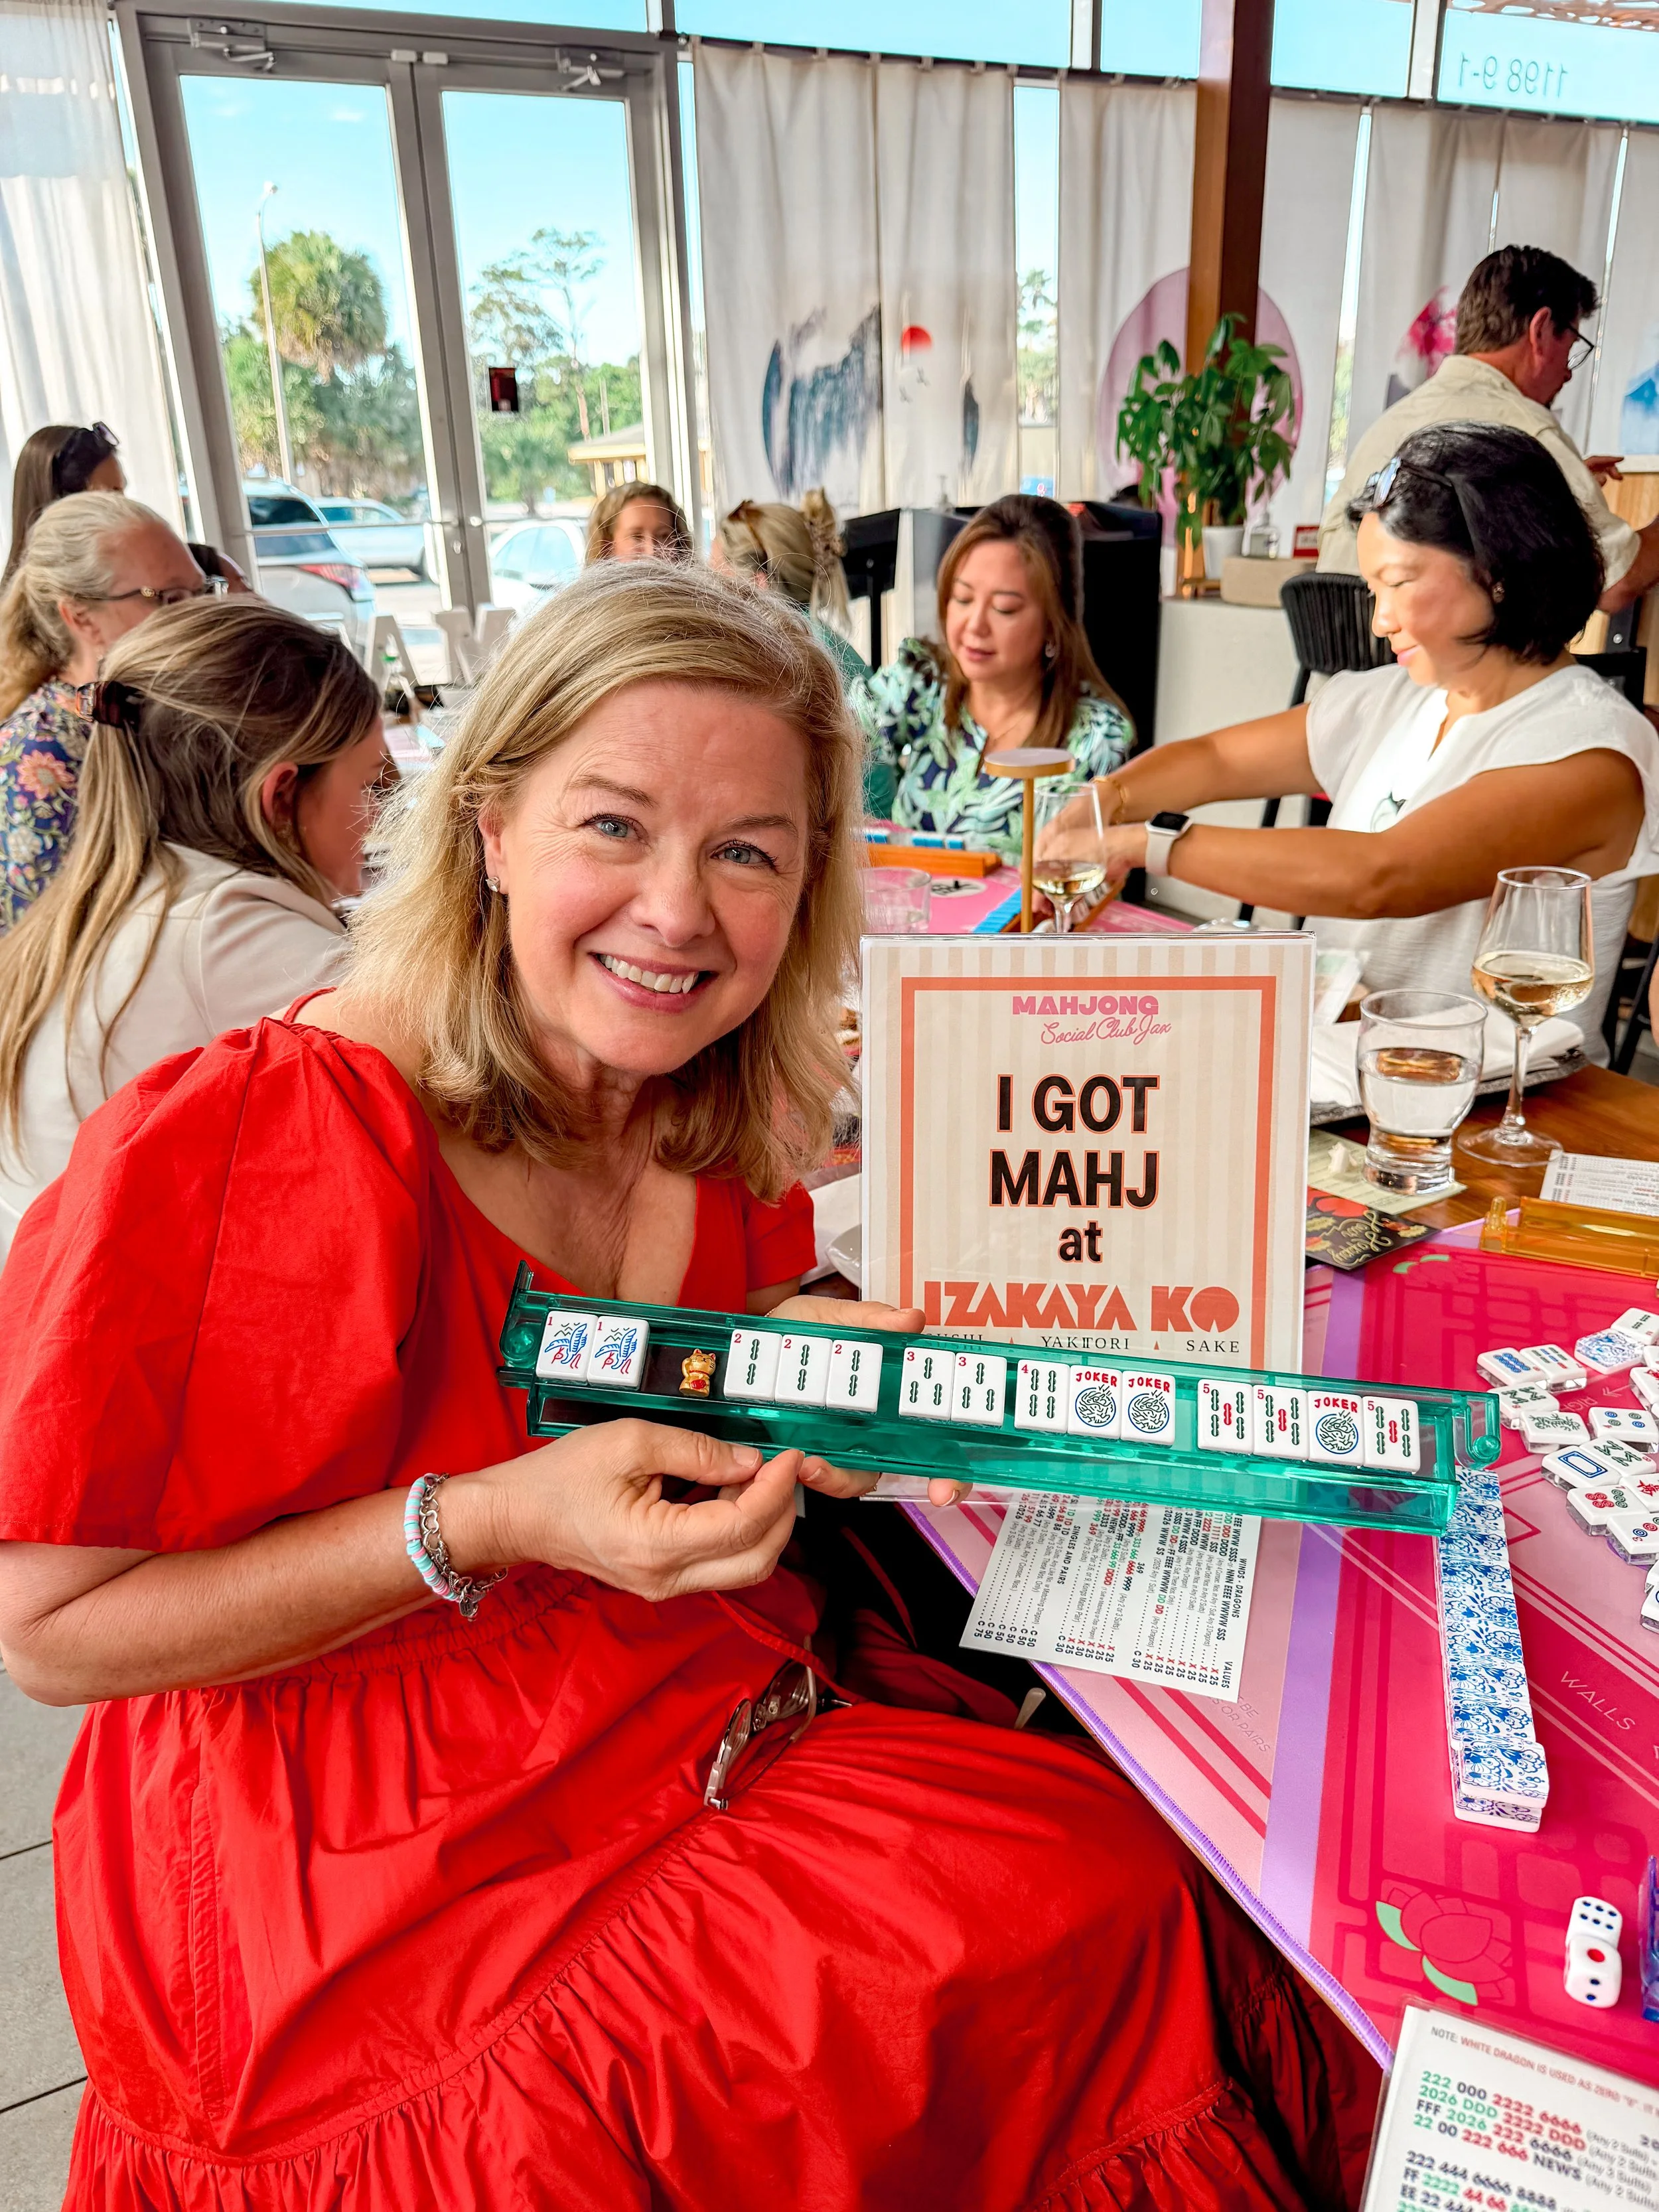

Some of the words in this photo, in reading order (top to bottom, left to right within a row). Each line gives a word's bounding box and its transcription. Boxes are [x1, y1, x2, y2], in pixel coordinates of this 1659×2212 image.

[1013, 995, 1159, 1015] MAHJONG
[1041, 1021, 1096, 1044] Social
[1096, 1017, 1137, 1039] Club
[997, 1074, 1013, 1133] I
[1031, 1073, 1160, 1134] GOT
[989, 1149, 1160, 1209] MAHJ
[1057, 1220, 1103, 1263] at
[924, 1281, 1138, 1331] IZAKAYA
[1151, 1286, 1240, 1333] KO
[547, 1316, 553, 1326] 1
[597, 1321, 603, 1331] 1
[734, 1333, 742, 1344] 2
[784, 1338, 792, 1349] 2
[1041, 1336, 1129, 1350] YAKITORI
[1187, 1339, 1240, 1353] SAKE
[835, 1344, 843, 1355] 2
[907, 1351, 915, 1361] 3
[959, 1357, 967, 1366] 3
[1021, 1364, 1029, 1373] 4
[1076, 1371, 1118, 1387] JOKER
[1128, 1377, 1170, 1393] JOKER
[1203, 1384, 1210, 1394] 5
[1258, 1390, 1264, 1400] 5
[1314, 1397, 1358, 1414] JOKER
[1368, 1401, 1374, 1411] 5
[1099, 1513, 1110, 1527] 3333
[1107, 1517, 1118, 1534] NEWS
[1181, 1517, 1192, 1534] WWW
[1192, 1518, 1201, 1527] FFF
[1202, 1518, 1212, 1532] 2222
[1233, 1517, 1242, 1526] EEE
[1088, 1522, 1098, 1534] 369
[1171, 1525, 1179, 1534] DD
[1066, 1525, 1081, 1549] SINGLES
[1132, 1538, 1141, 1548] 333
[1157, 1527, 1169, 1545] WWW
[1189, 1528, 1200, 1545] DDDD
[1198, 1533, 1209, 1550] WWW
[1230, 1528, 1240, 1546] WWW
[1177, 1539, 1187, 1553] SSSS
[1208, 1541, 1218, 1552] SSS
[1218, 1538, 1228, 1556] DDDD
[1062, 1550, 1073, 1564] AND
[1129, 1548, 1139, 1559] 666
[1228, 1547, 1238, 1562] SSSS
[1125, 1560, 1135, 1575] 6666
[1135, 1562, 1145, 1574] 369
[1164, 1556, 1173, 1568] EEEE
[1236, 1558, 1247, 1578] WINDS
[1056, 1566, 1068, 1584] PAIRS
[1159, 1569, 1171, 1593] WWWW
[1224, 1568, 1234, 1584] NNN
[1121, 1576, 1132, 1591] 9999
[1156, 1593, 1166, 1603] DD
[1222, 1584, 1232, 1598] EEEE
[1231, 1584, 1243, 1618] DRAGONS
[1155, 1604, 1164, 1614] DD
[1218, 1600, 1230, 1627] WWWW
[1216, 1627, 1226, 1641] SSS
[1131, 1658, 1140, 1668] 30
[1143, 1660, 1152, 1670] 25
[1153, 1662, 1163, 1672] 25
[1165, 1665, 1174, 1675] 25
[1175, 1667, 1185, 1678] 25
[1187, 1670, 1196, 1680] 25
[1198, 1672, 1207, 1683] 25
[1220, 1660, 1232, 1688] VALUES
[1208, 1675, 1218, 1686] 25
[1560, 1670, 1636, 1730] WALLS
[1221, 1706, 1240, 1722] OR
[1238, 1723, 1271, 1753] PAIRS
[1431, 2026, 1459, 2043] NOTE:
[1461, 2035, 1492, 2055] WHITE
[1421, 2071, 1452, 2089] 222
[1492, 2093, 1534, 2118] 2222
[1539, 2110, 1582, 2136] 6666
[1418, 2085, 1457, 2106] 2026
[1462, 2097, 1498, 2118] DDD
[1503, 2111, 1544, 2136] 2222
[1548, 2128, 1587, 2152] DDD
[1416, 2098, 1441, 2116] FFF
[1446, 2108, 1487, 2131] 2026
[1492, 2122, 1524, 2145] 222
[1530, 2136, 1572, 2162] 6666
[1413, 2112, 1433, 2130] 22
[1461, 2128, 1493, 2150] 222
[1497, 2141, 1529, 2162] 666
[1532, 2151, 1583, 2182] NEWS
[1405, 2149, 1435, 2171] 222
